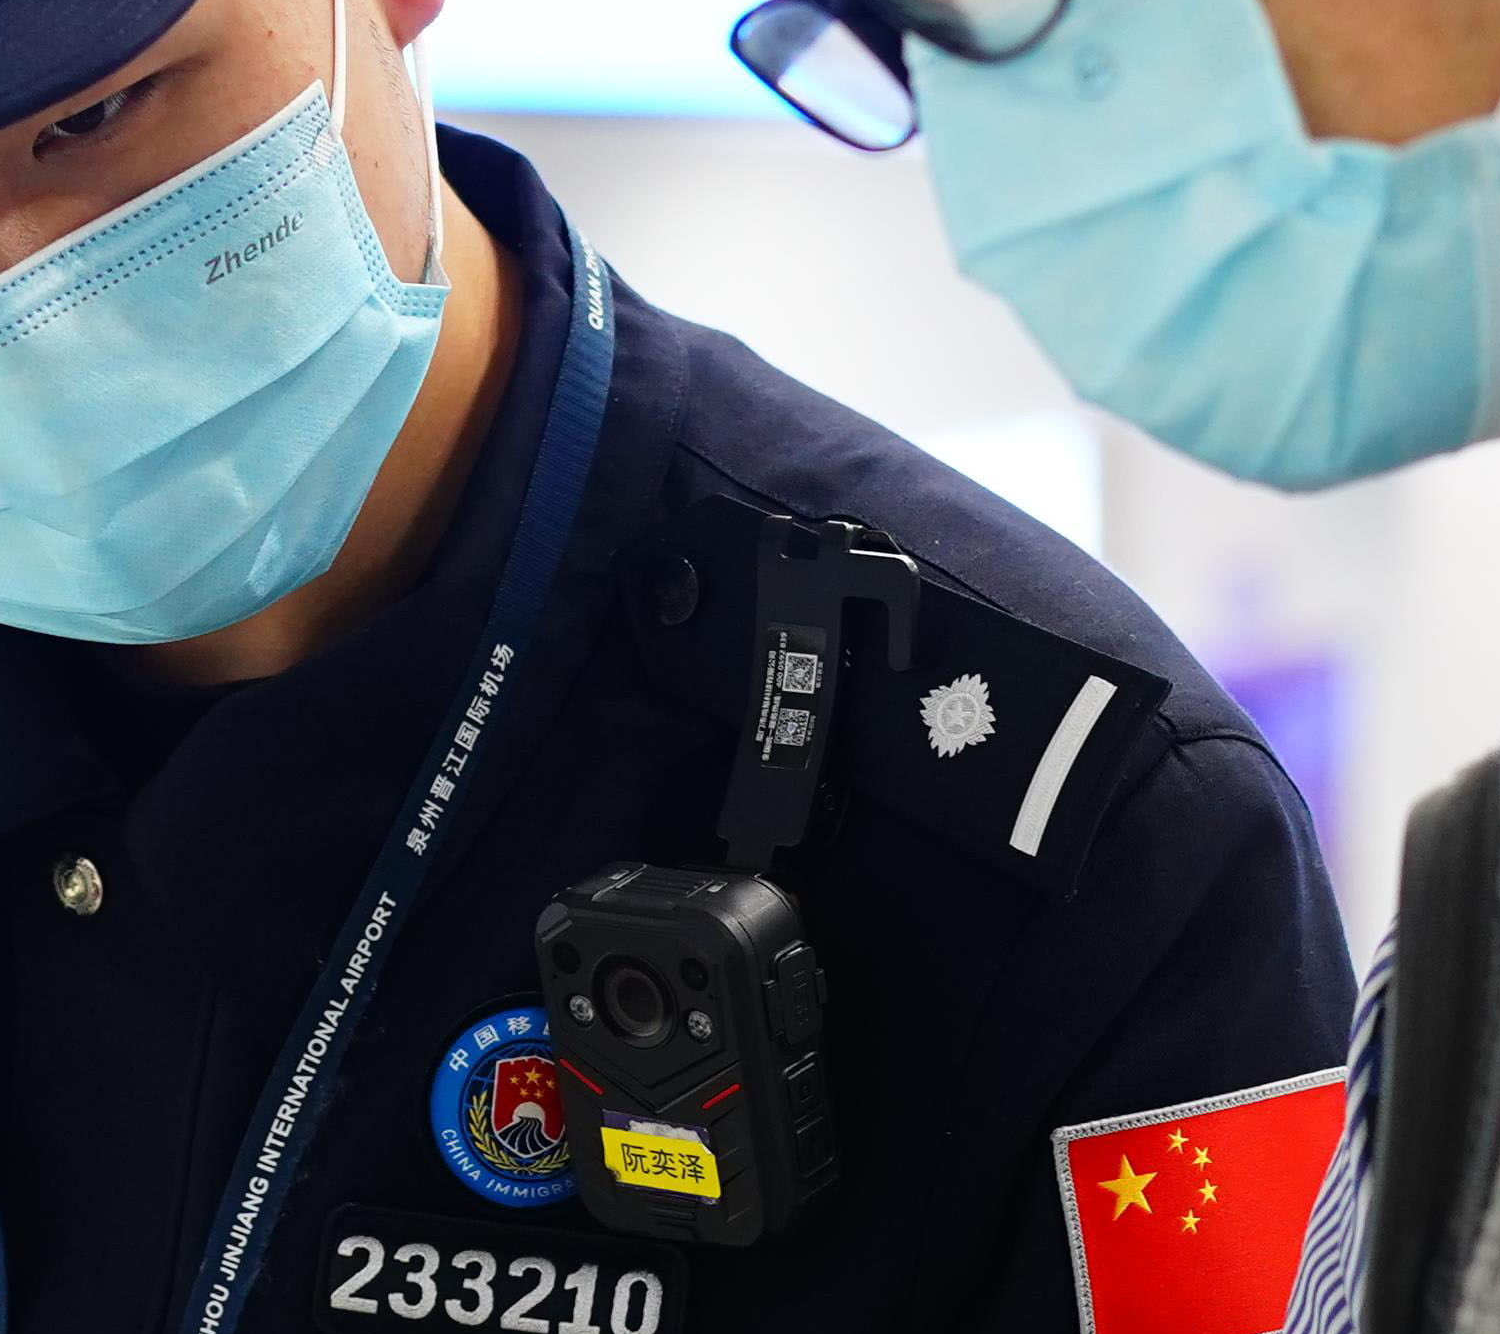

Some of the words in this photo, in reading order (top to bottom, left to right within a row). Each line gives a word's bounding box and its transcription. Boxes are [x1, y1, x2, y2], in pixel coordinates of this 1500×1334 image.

[203, 210, 305, 285] Zhende
[588, 273, 604, 331] QUAN
[405, 642, 515, 856] 泉州晋江国际机场
[218, 1175, 270, 1282] JINJIANG
[256, 997, 350, 1173] INTERNATIONAL
[340, 890, 398, 996] AIRPORT
[440, 1128, 482, 1182] CHINA
[620, 1142, 707, 1184] 阮奕泽
